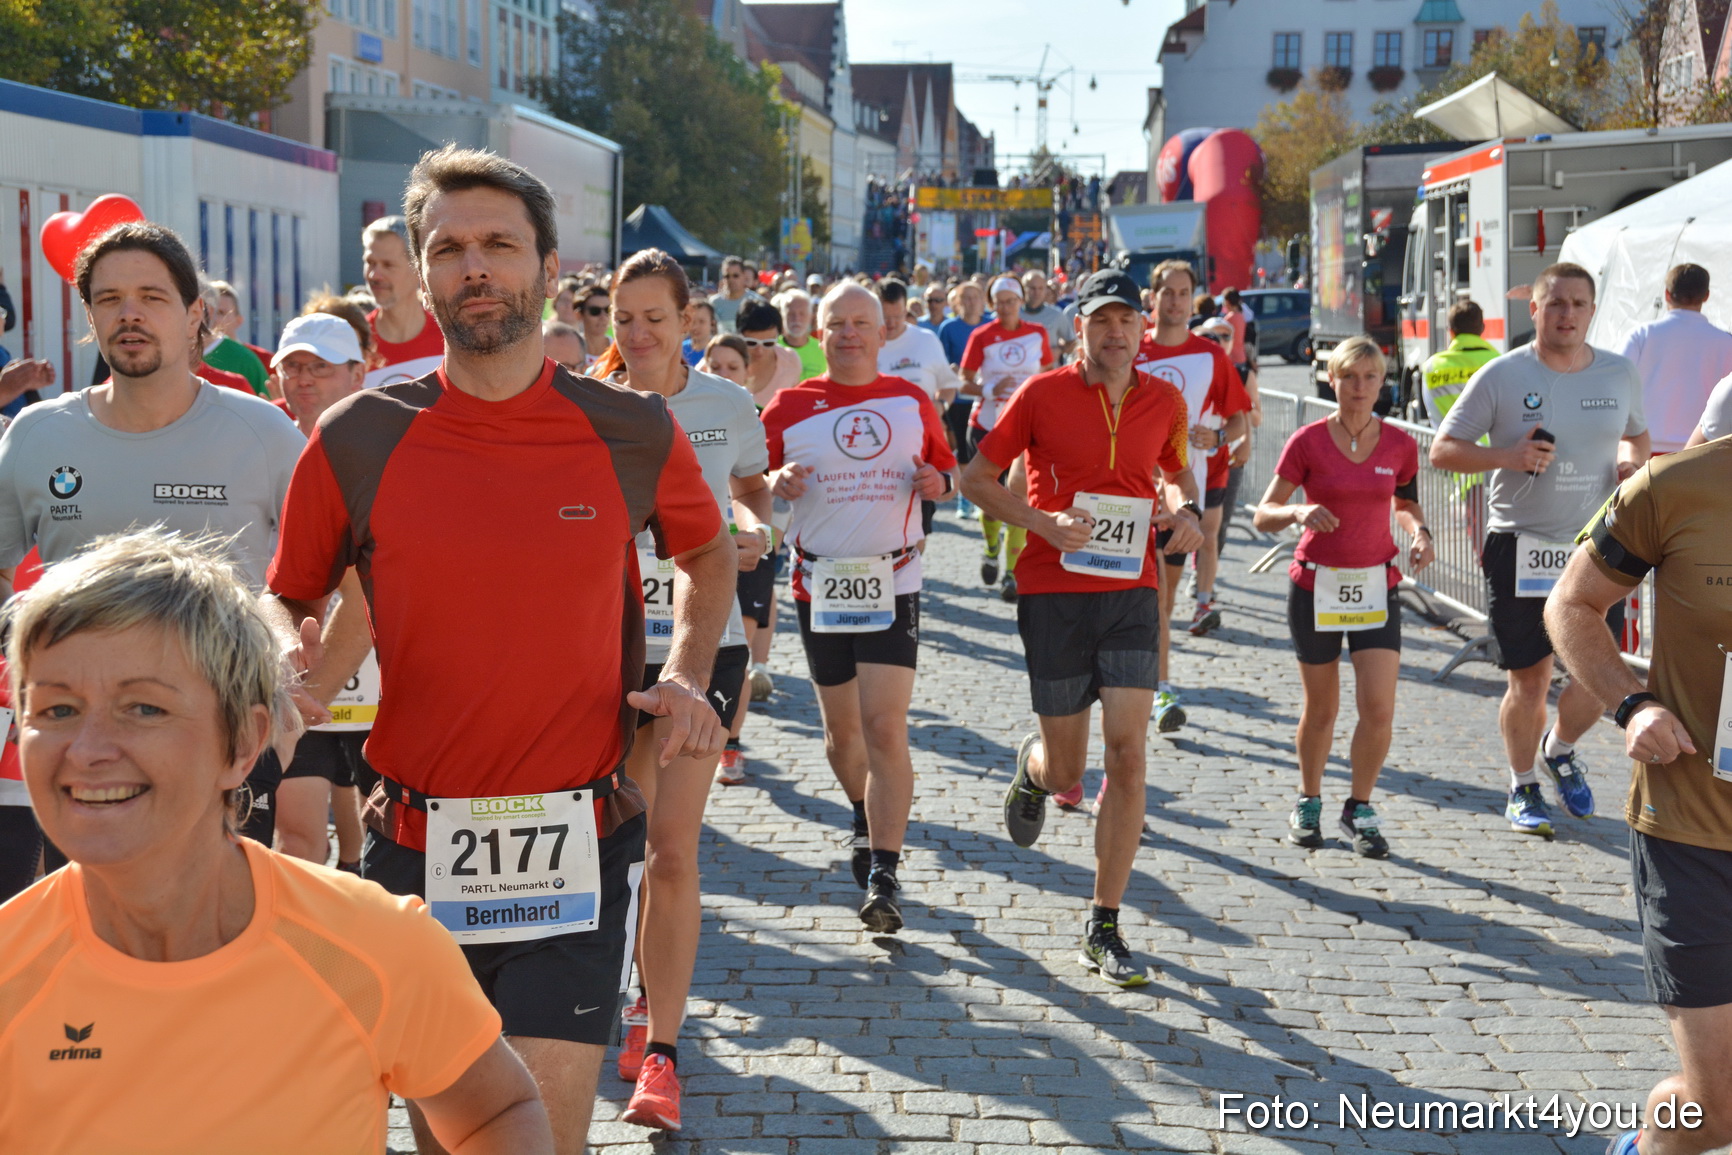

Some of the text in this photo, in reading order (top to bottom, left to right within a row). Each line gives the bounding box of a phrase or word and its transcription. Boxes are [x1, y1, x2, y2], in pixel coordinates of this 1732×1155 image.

[1581, 399, 1617, 408] BOCK
[687, 429, 727, 443] OCK
[1557, 462, 1577, 475] 19.
[154, 484, 227, 500] BOCK
[50, 504, 82, 513] PARTL
[1087, 556, 1121, 569] Jürgen
[1528, 550, 1573, 568] 308
[824, 578, 882, 599] 2303
[1339, 585, 1363, 603] 55
[836, 614, 870, 625] Jürgen
[1339, 615, 1364, 623] Maria
[471, 795, 545, 815] BOCK
[451, 824, 569, 875] 2177
[461, 881, 549, 894] PARTL Neumarkt
[466, 901, 560, 926] Bernhard
[49, 1045, 102, 1061] erima
